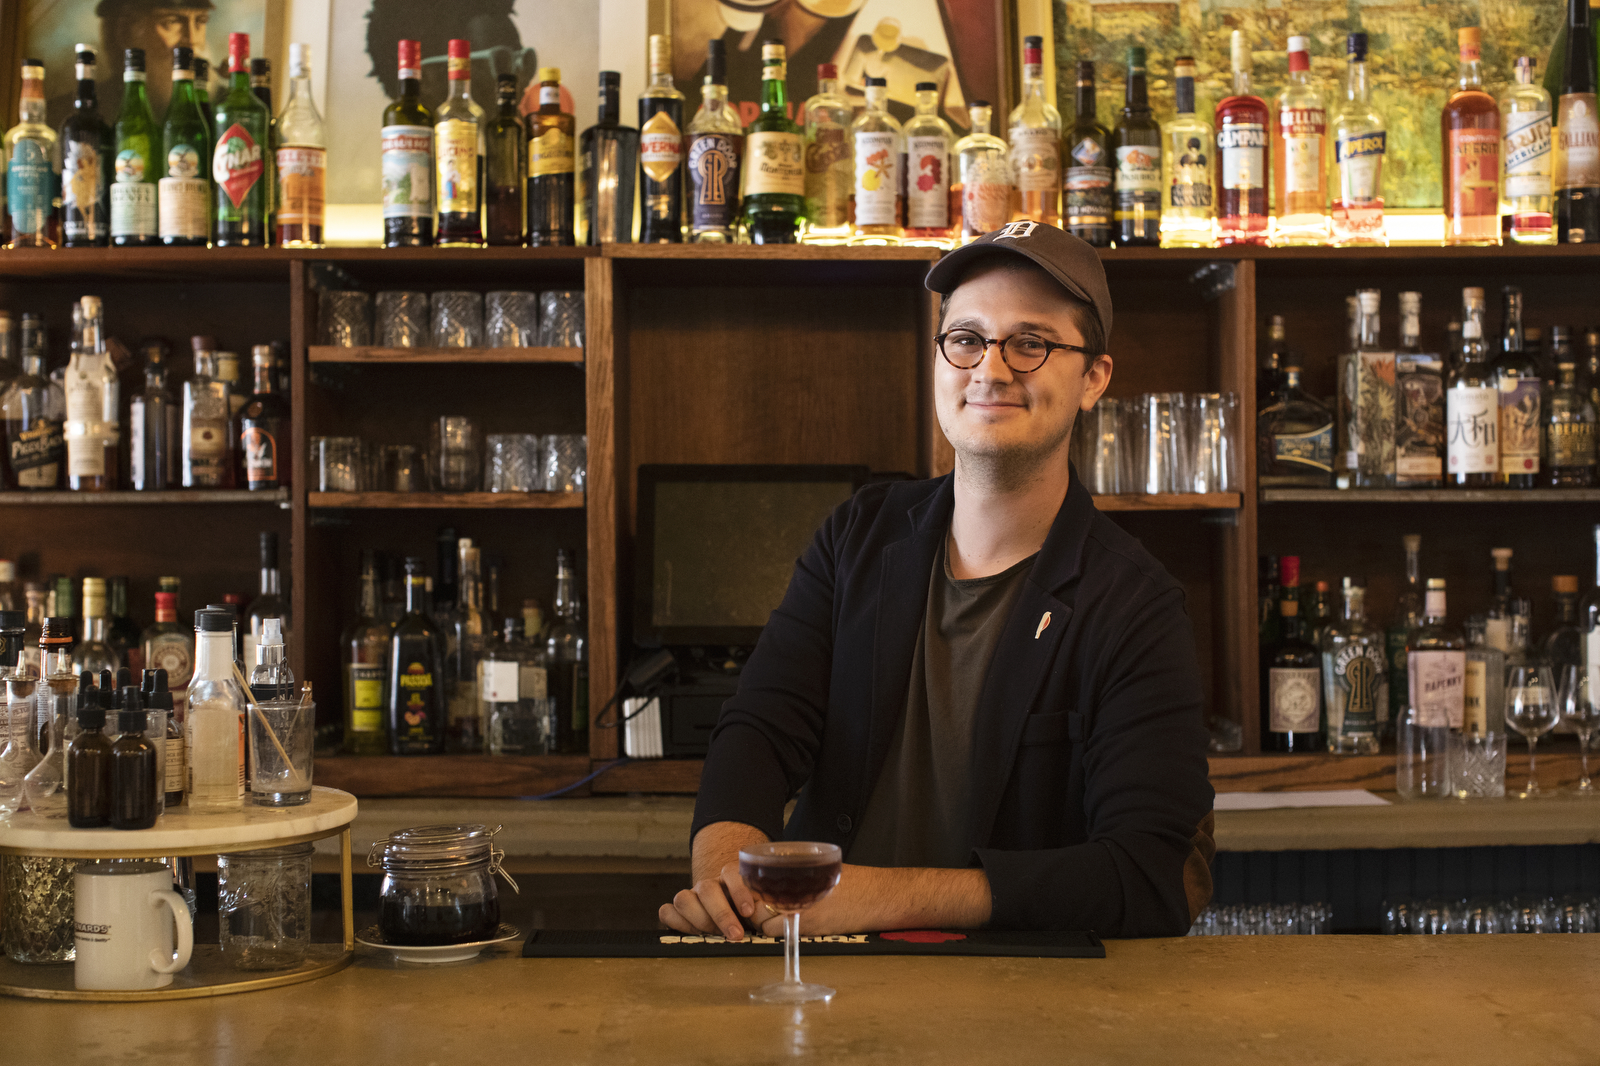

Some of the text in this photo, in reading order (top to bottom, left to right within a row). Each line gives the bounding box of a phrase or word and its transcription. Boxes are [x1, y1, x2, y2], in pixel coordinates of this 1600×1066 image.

[688, 137, 738, 169] GREEN DOOR
[1339, 135, 1384, 161] APEROL
[992, 220, 1040, 242] D
[1335, 645, 1364, 675] GREEN
[1365, 645, 1384, 674] DOOR
